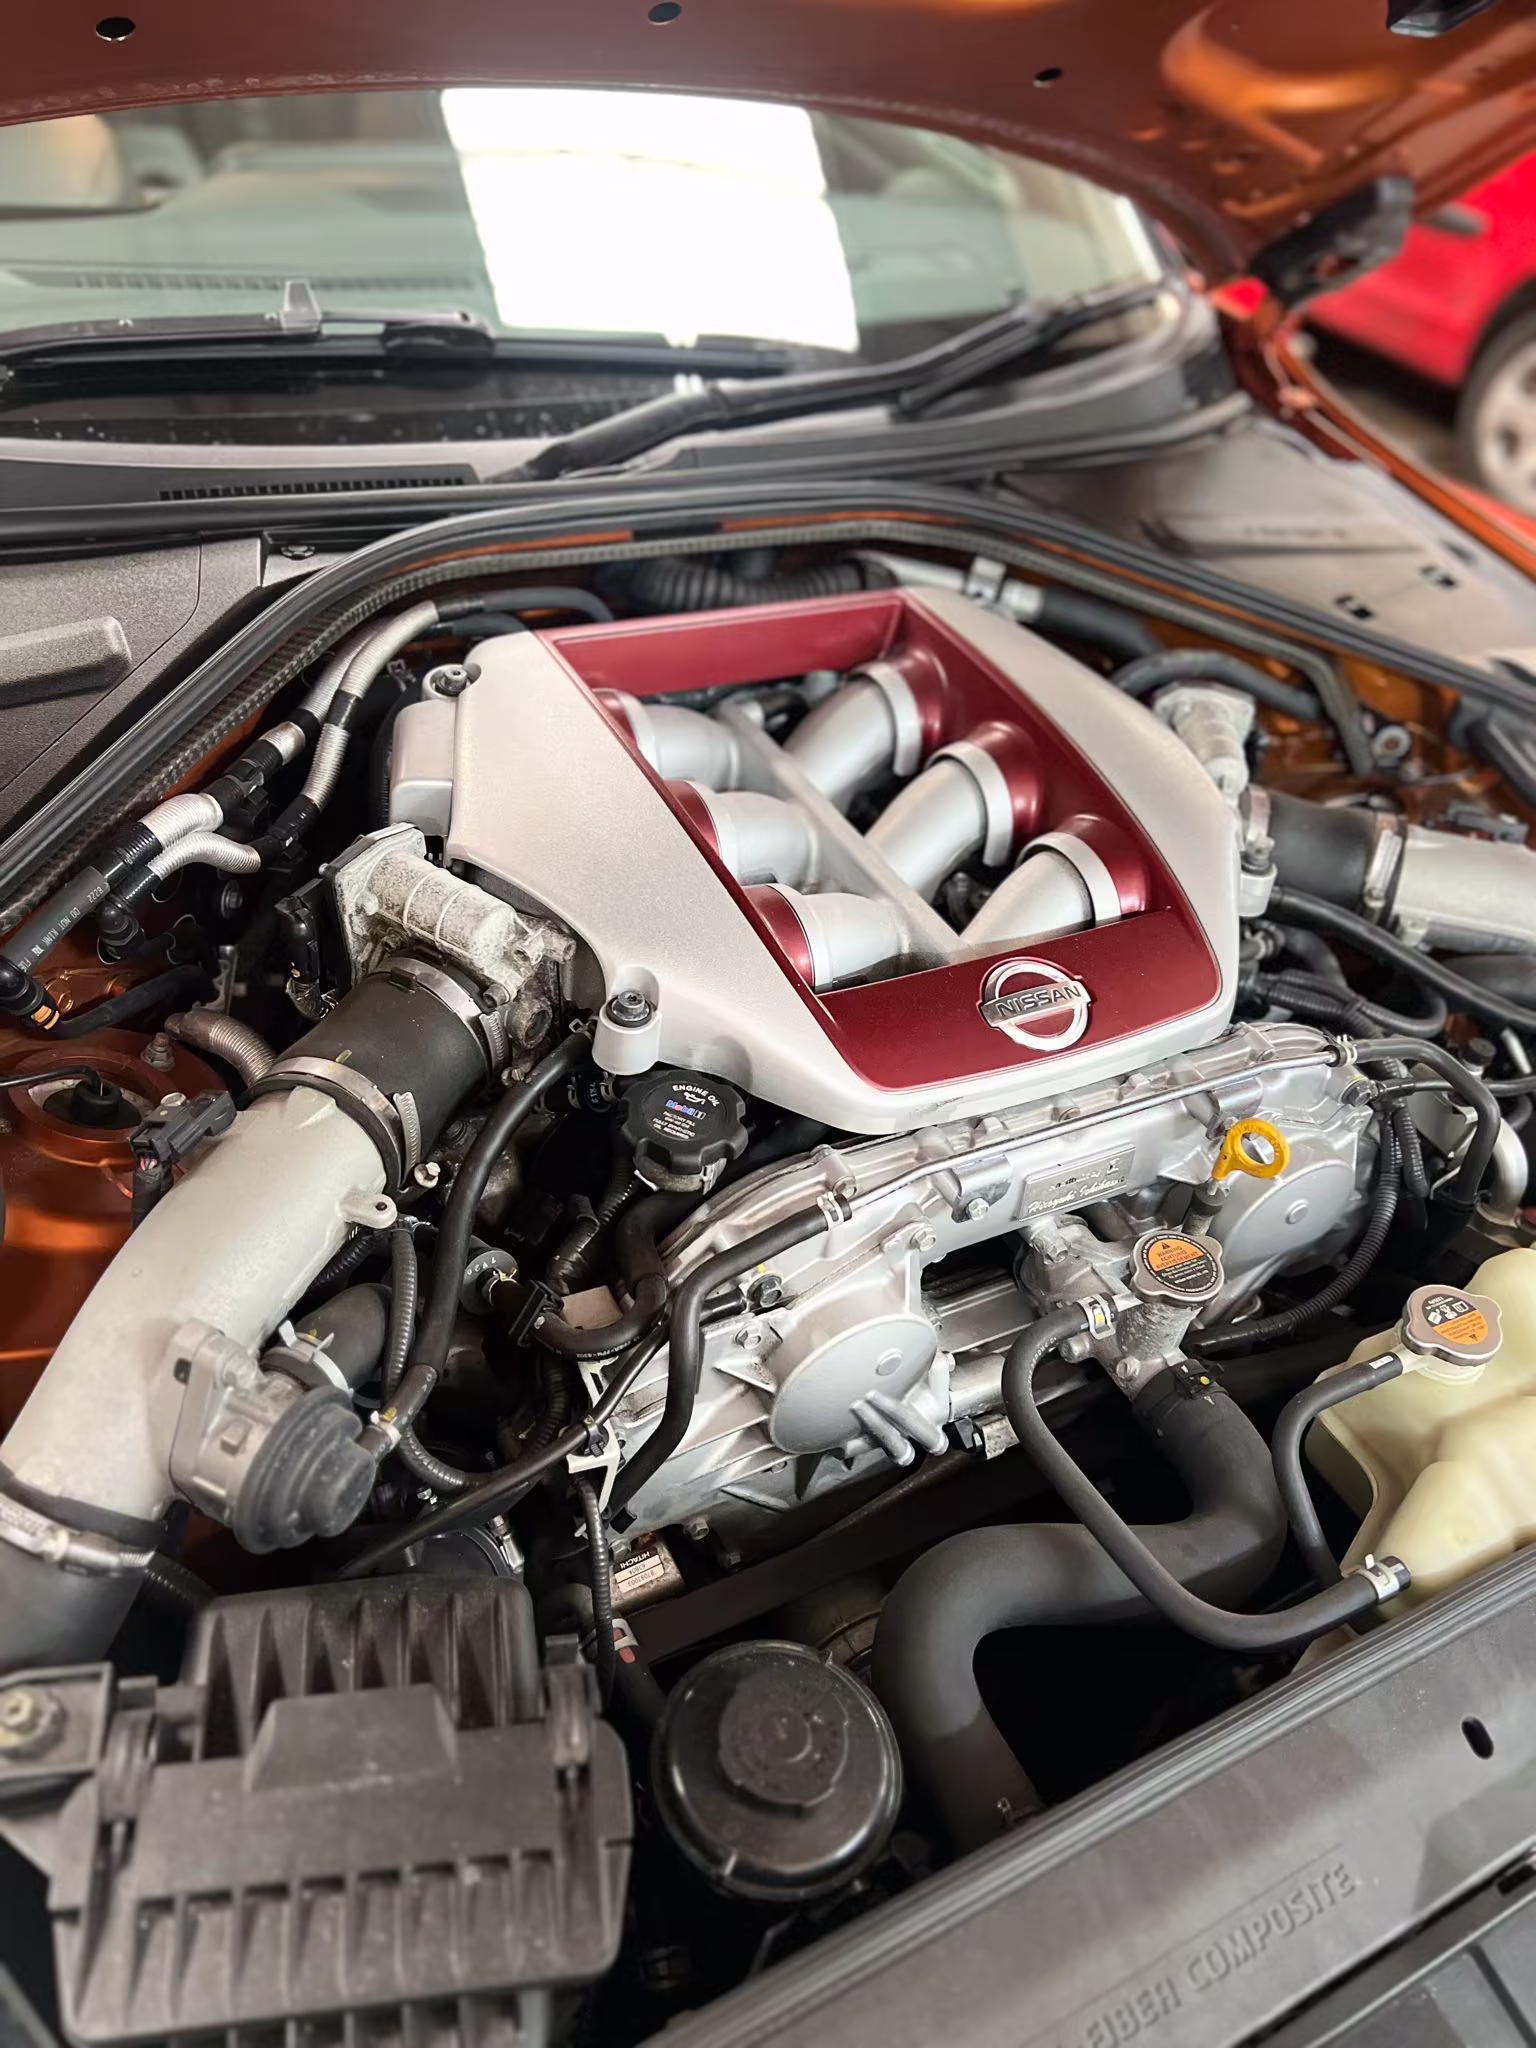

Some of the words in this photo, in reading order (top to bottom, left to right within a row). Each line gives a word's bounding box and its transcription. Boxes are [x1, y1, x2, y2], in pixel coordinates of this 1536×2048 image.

[69, 906, 81, 919] DO
[57, 915, 72, 931] NOT
[41, 927, 60, 947] KINK
[995, 984, 1083, 1018] NISSAN
[672, 1084, 709, 1096] ENGINE
[707, 1095, 720, 1107] OIL
[1156, 1246, 1183, 1257] WARNING
[620, 1551, 650, 1570] HITACHI
[1186, 1861, 1357, 1994] COMPOSITE
